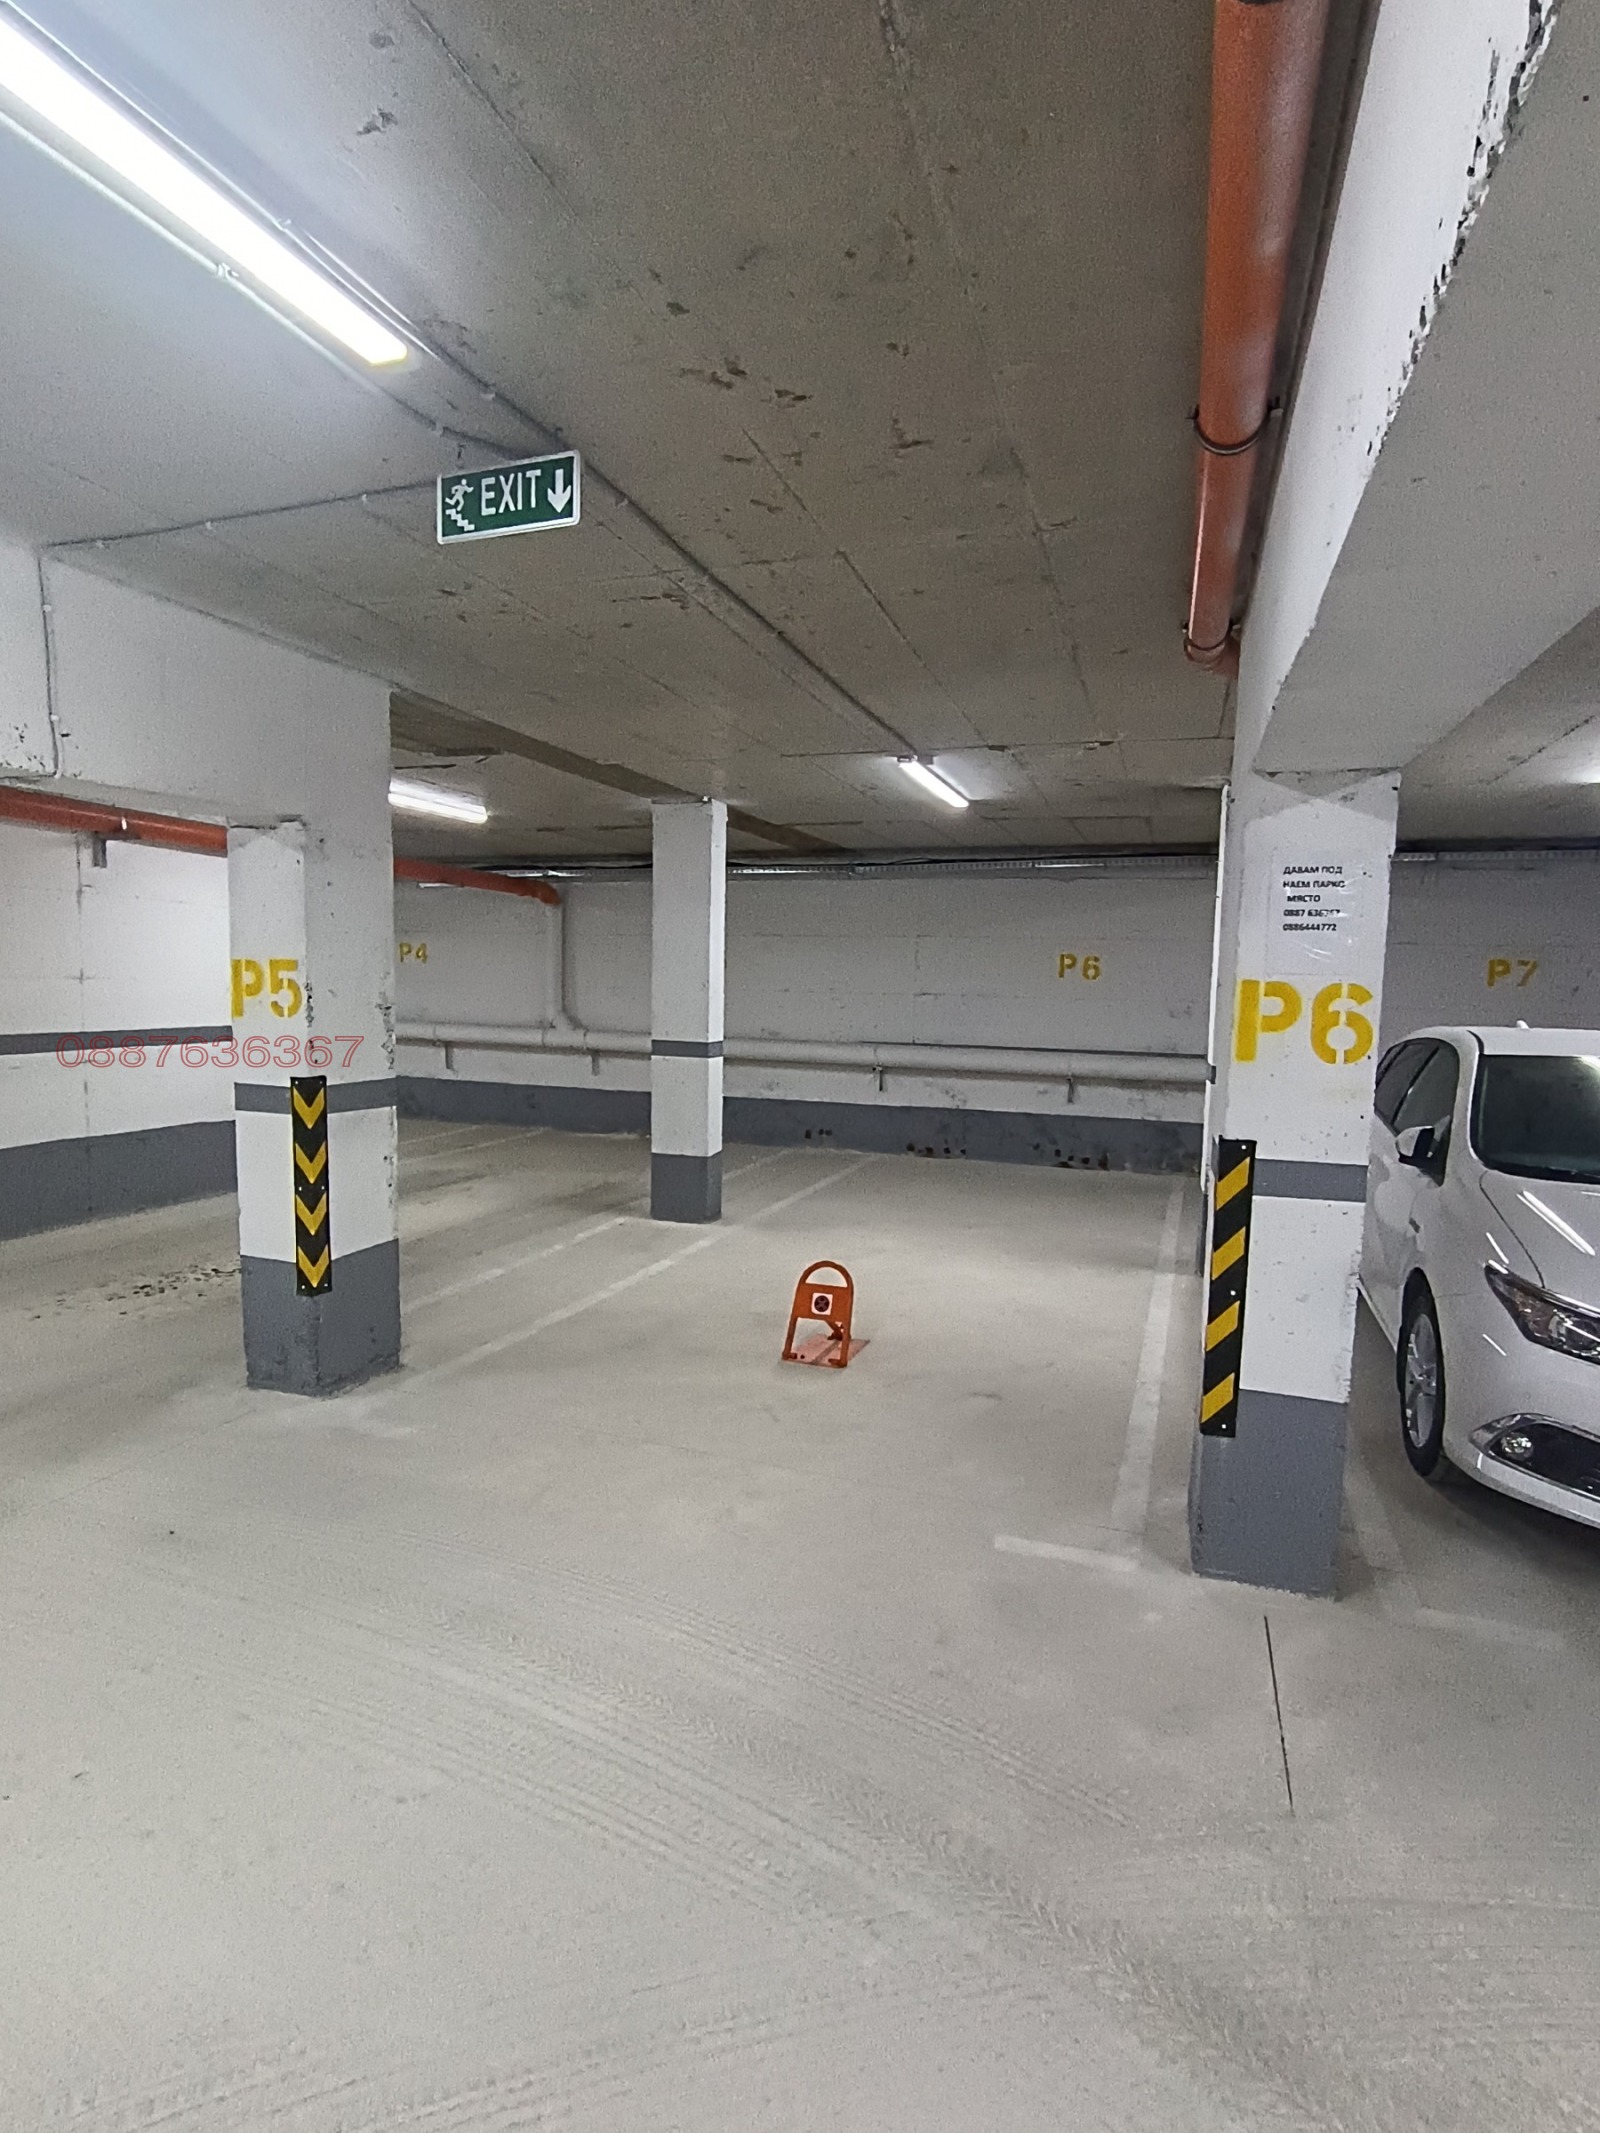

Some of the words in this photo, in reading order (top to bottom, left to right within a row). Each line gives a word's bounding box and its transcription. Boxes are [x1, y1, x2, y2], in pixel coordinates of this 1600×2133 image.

[480, 469, 542, 516] EXIT
[1283, 866, 1320, 875] ДАВАМ
[1321, 866, 1343, 875] ПОД
[399, 942, 428, 964] P4
[1058, 953, 1101, 980] P6
[231, 958, 303, 1018] P5
[1486, 958, 1539, 988] P7
[1234, 979, 1374, 1065] P6
